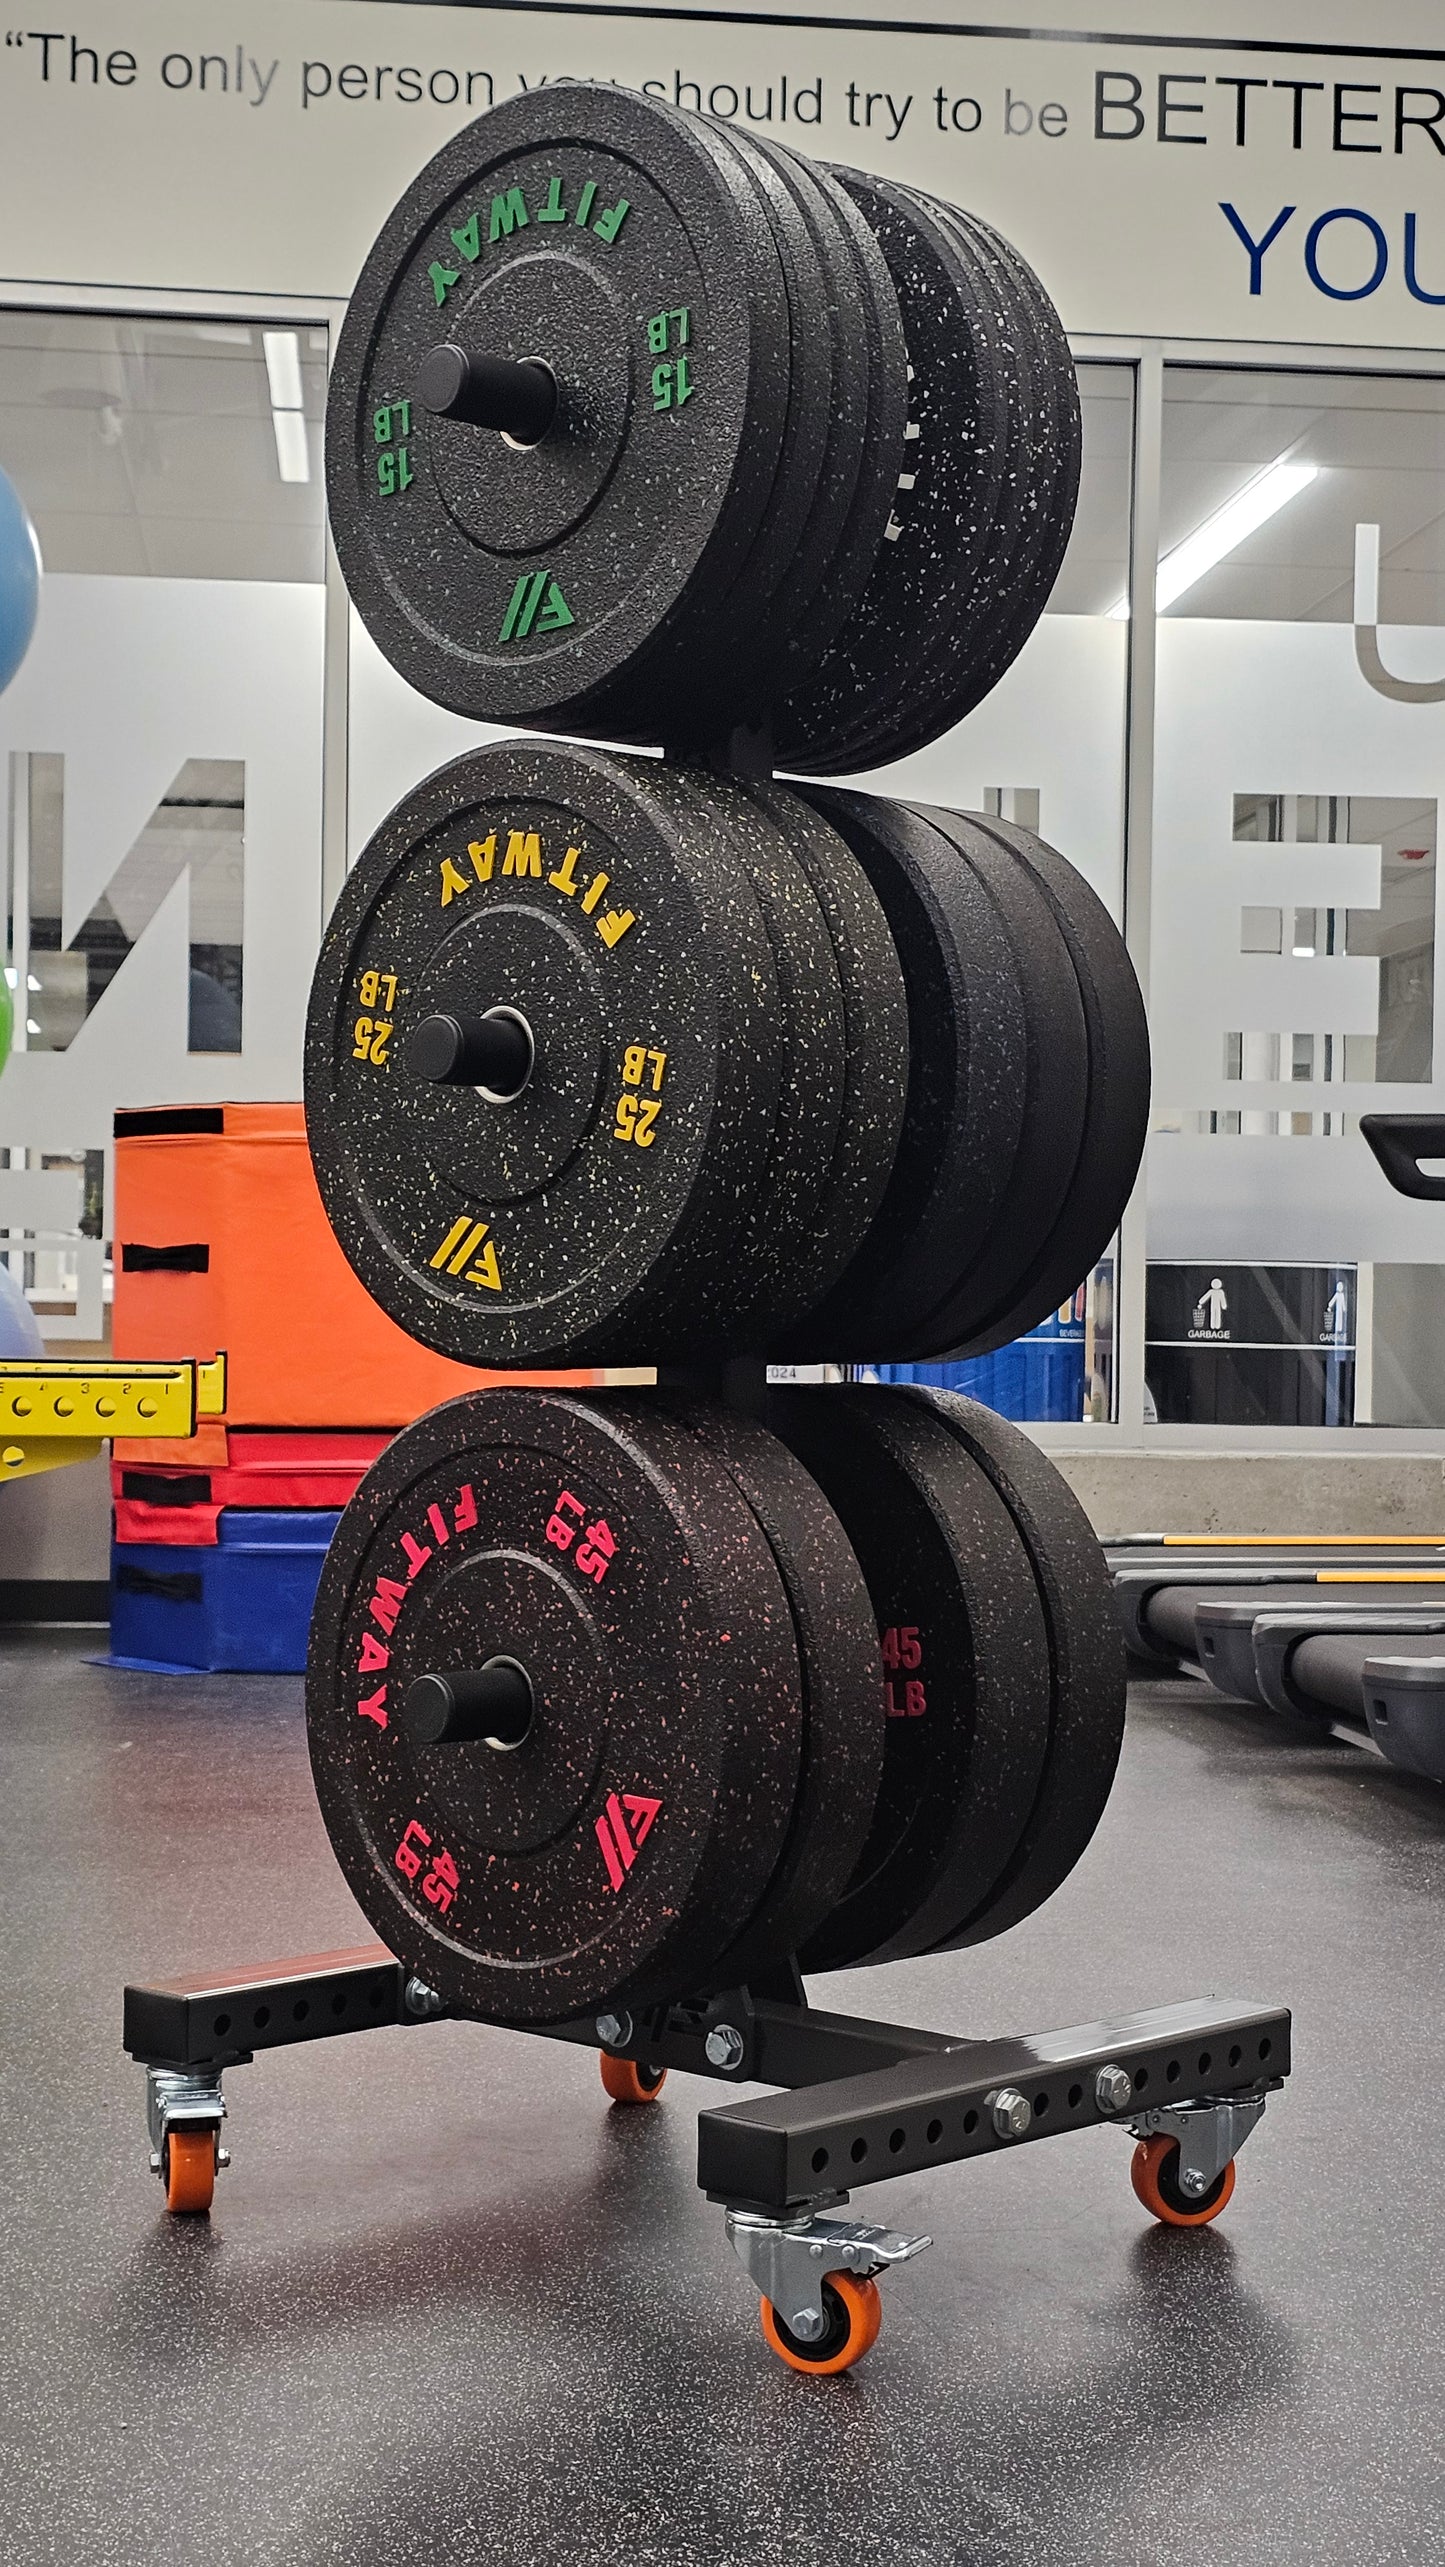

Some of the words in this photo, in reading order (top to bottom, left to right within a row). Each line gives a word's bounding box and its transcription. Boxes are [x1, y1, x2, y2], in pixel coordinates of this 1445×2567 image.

[159, 45, 280, 108] only
[301, 60, 494, 109] person
[642, 69, 823, 125] should
[845, 81, 914, 142] try
[933, 86, 983, 133] to
[1004, 88, 1069, 138] be
[1093, 70, 1445, 156] BETTER
[427, 178, 631, 307] FITWAY
[647, 307, 691, 354] LB
[652, 355, 693, 411] 15
[373, 400, 411, 443] LB
[376, 447, 413, 496] 15
[440, 831, 636, 949] FITWAY
[360, 971, 398, 1012] LB
[353, 1016, 393, 1066] 25
[623, 1045, 667, 1091] LB
[615, 1095, 661, 1148] 25
[1187, 1329, 1231, 1340] GARBAGE
[768, 1366, 796, 1378] 024
[546, 1490, 587, 1551] LB
[575, 1519, 616, 1584] 45
[357, 1485, 478, 1729] FITWAY
[882, 1626, 922, 1669] 45
[885, 1680, 927, 1717] LB
[395, 1819, 433, 1879] LB
[422, 1850, 461, 1913] 45
